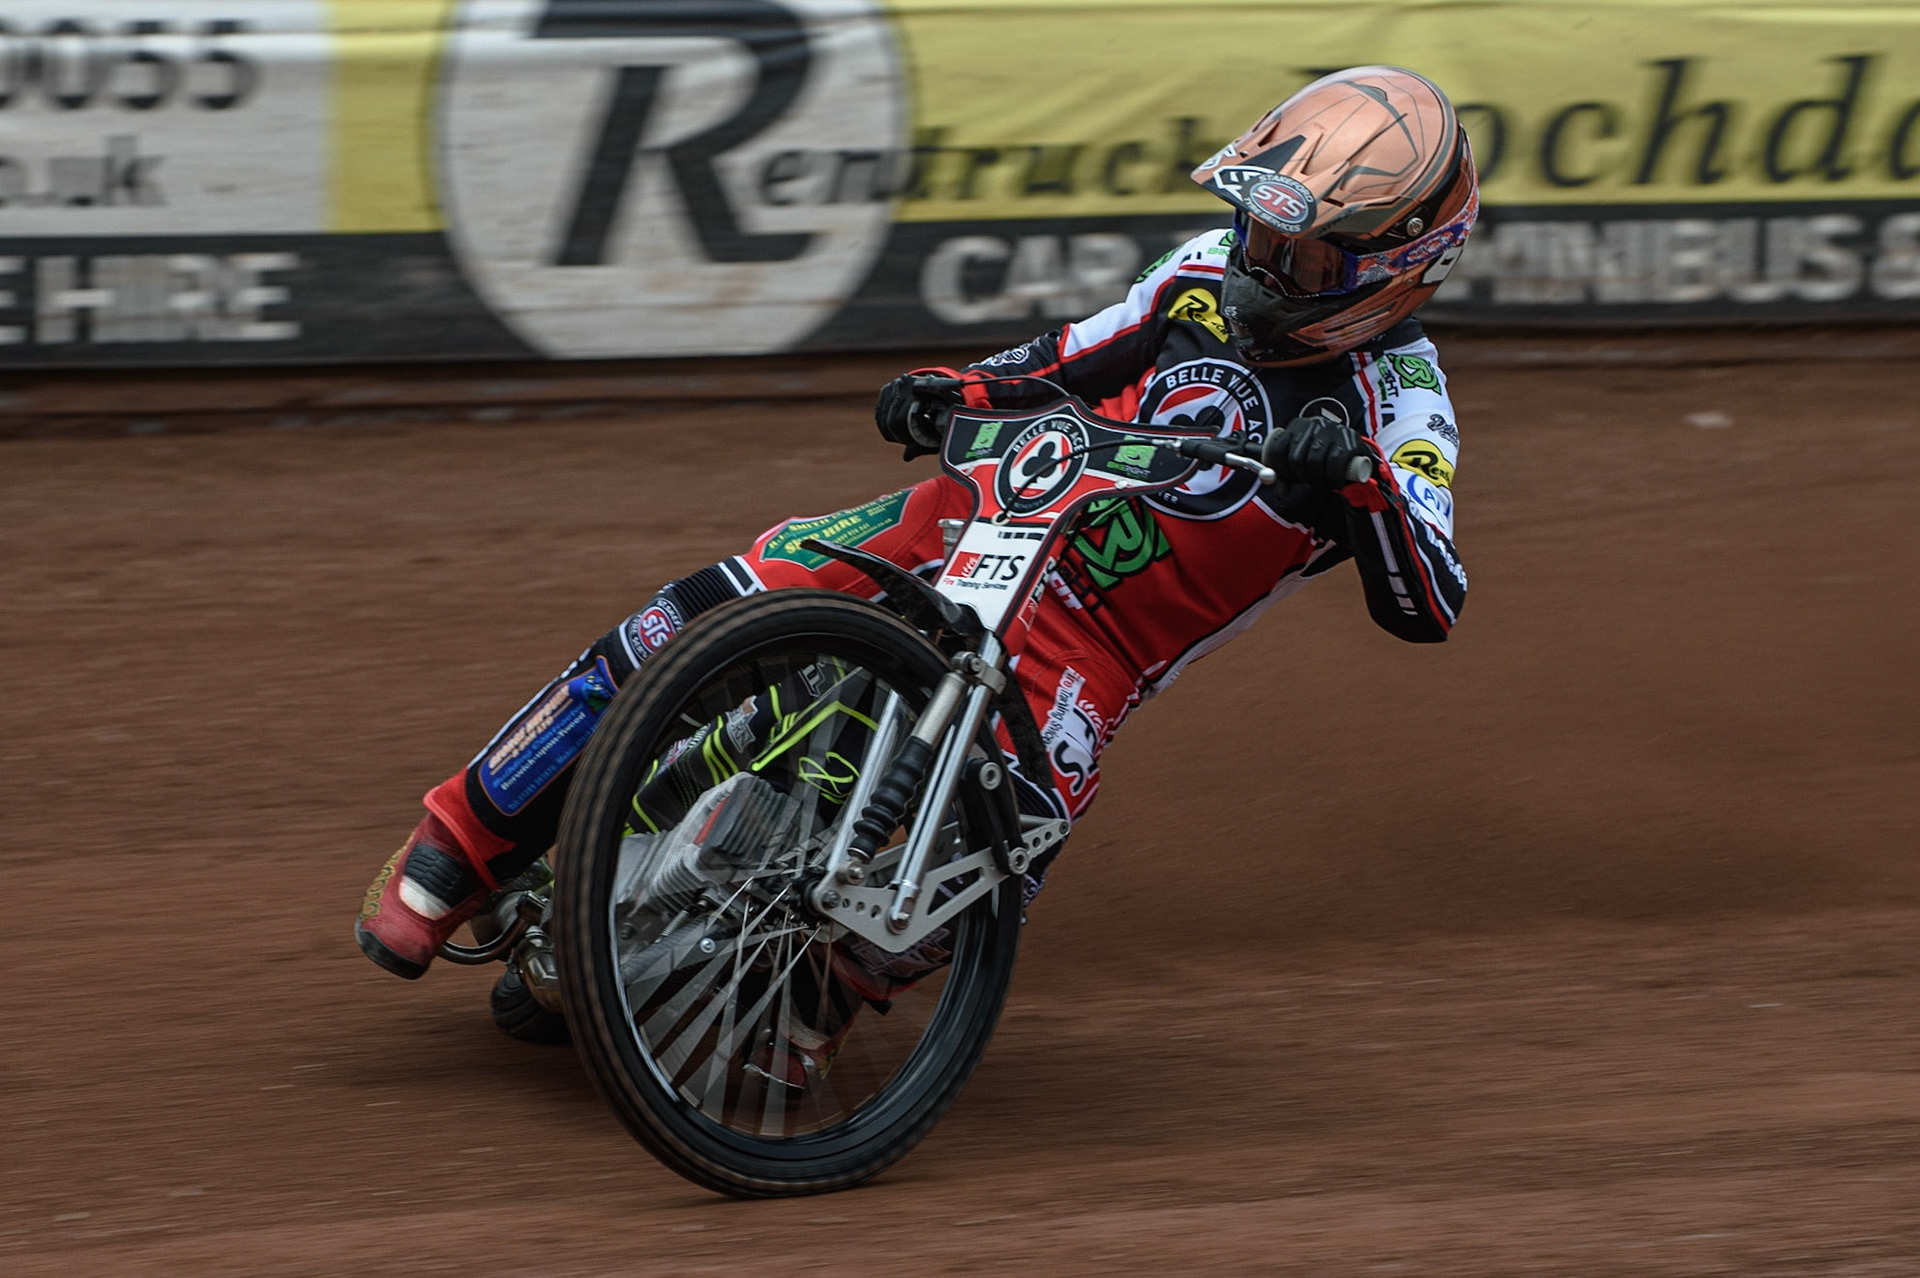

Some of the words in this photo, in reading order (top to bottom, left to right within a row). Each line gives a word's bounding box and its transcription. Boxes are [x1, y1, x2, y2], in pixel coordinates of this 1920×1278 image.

[1252, 184, 1306, 218] STS
[921, 234, 1140, 324] CAR
[1165, 366, 1225, 389] BELLE
[1227, 373, 1260, 412] VUE
[1012, 422, 1047, 453] BELLE
[1050, 420, 1074, 433] VUE
[788, 517, 830, 533] SMITH
[823, 515, 862, 537] HIRE
[970, 554, 1027, 581] FTS
[957, 579, 981, 591] Training
[981, 582, 1009, 591] Services
[642, 614, 671, 648] STS
